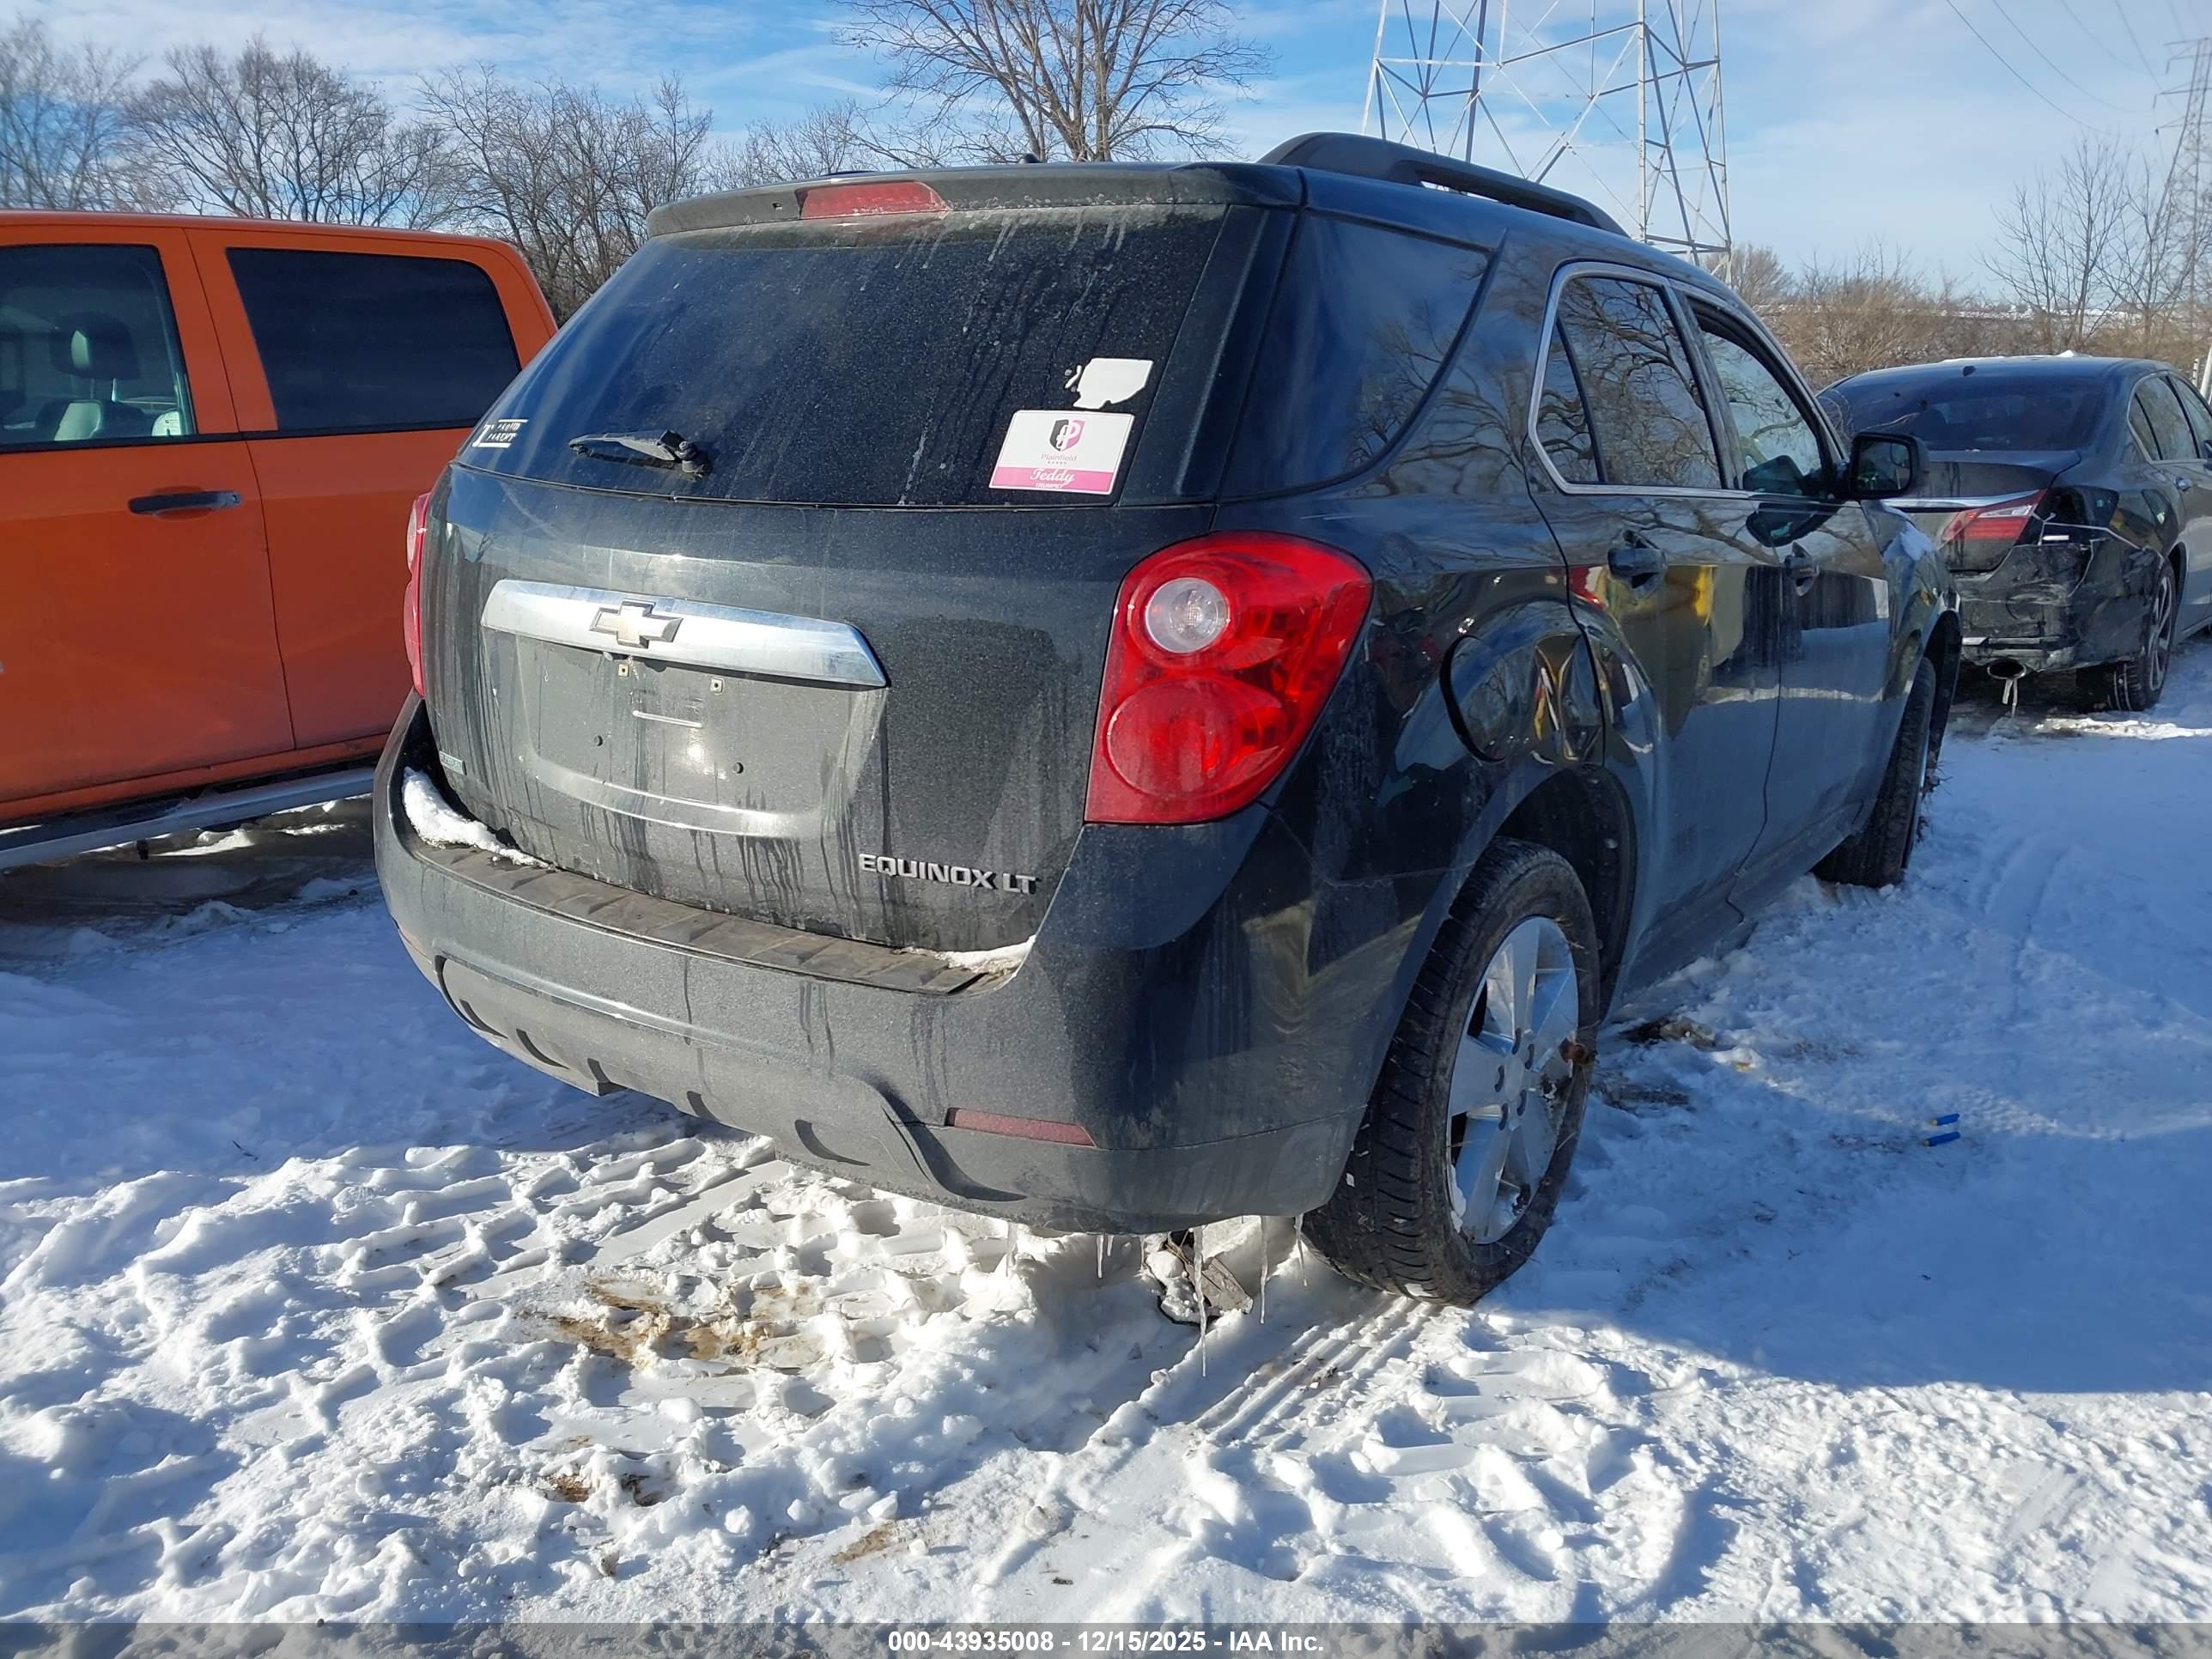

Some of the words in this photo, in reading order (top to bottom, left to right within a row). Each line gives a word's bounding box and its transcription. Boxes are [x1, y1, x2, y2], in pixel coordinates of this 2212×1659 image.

[1030, 468, 1076, 485] Teddy
[859, 854, 994, 890] EQUINOX
[1003, 872, 1036, 894] LT
